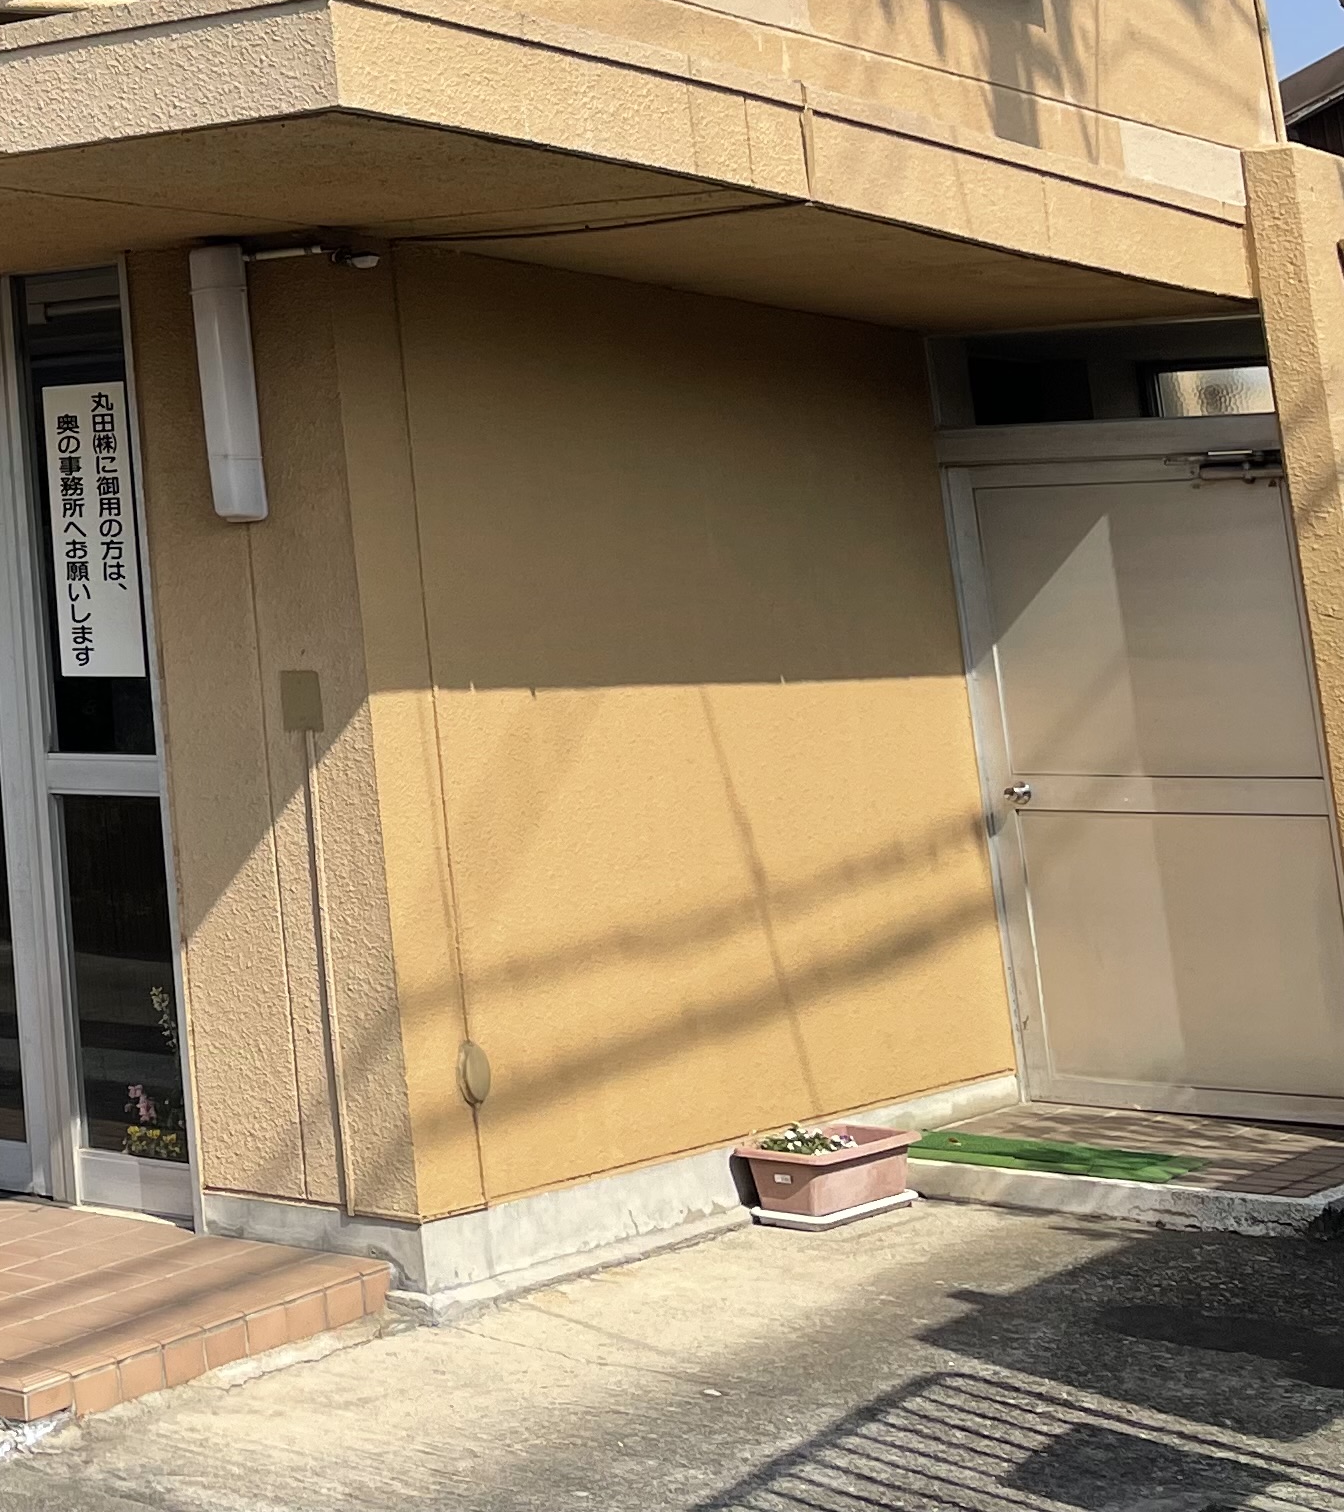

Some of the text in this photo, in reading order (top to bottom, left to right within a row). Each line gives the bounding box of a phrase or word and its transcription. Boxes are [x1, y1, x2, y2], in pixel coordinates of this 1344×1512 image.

[56, 413, 95, 667] 奥の事務所へお願いします
